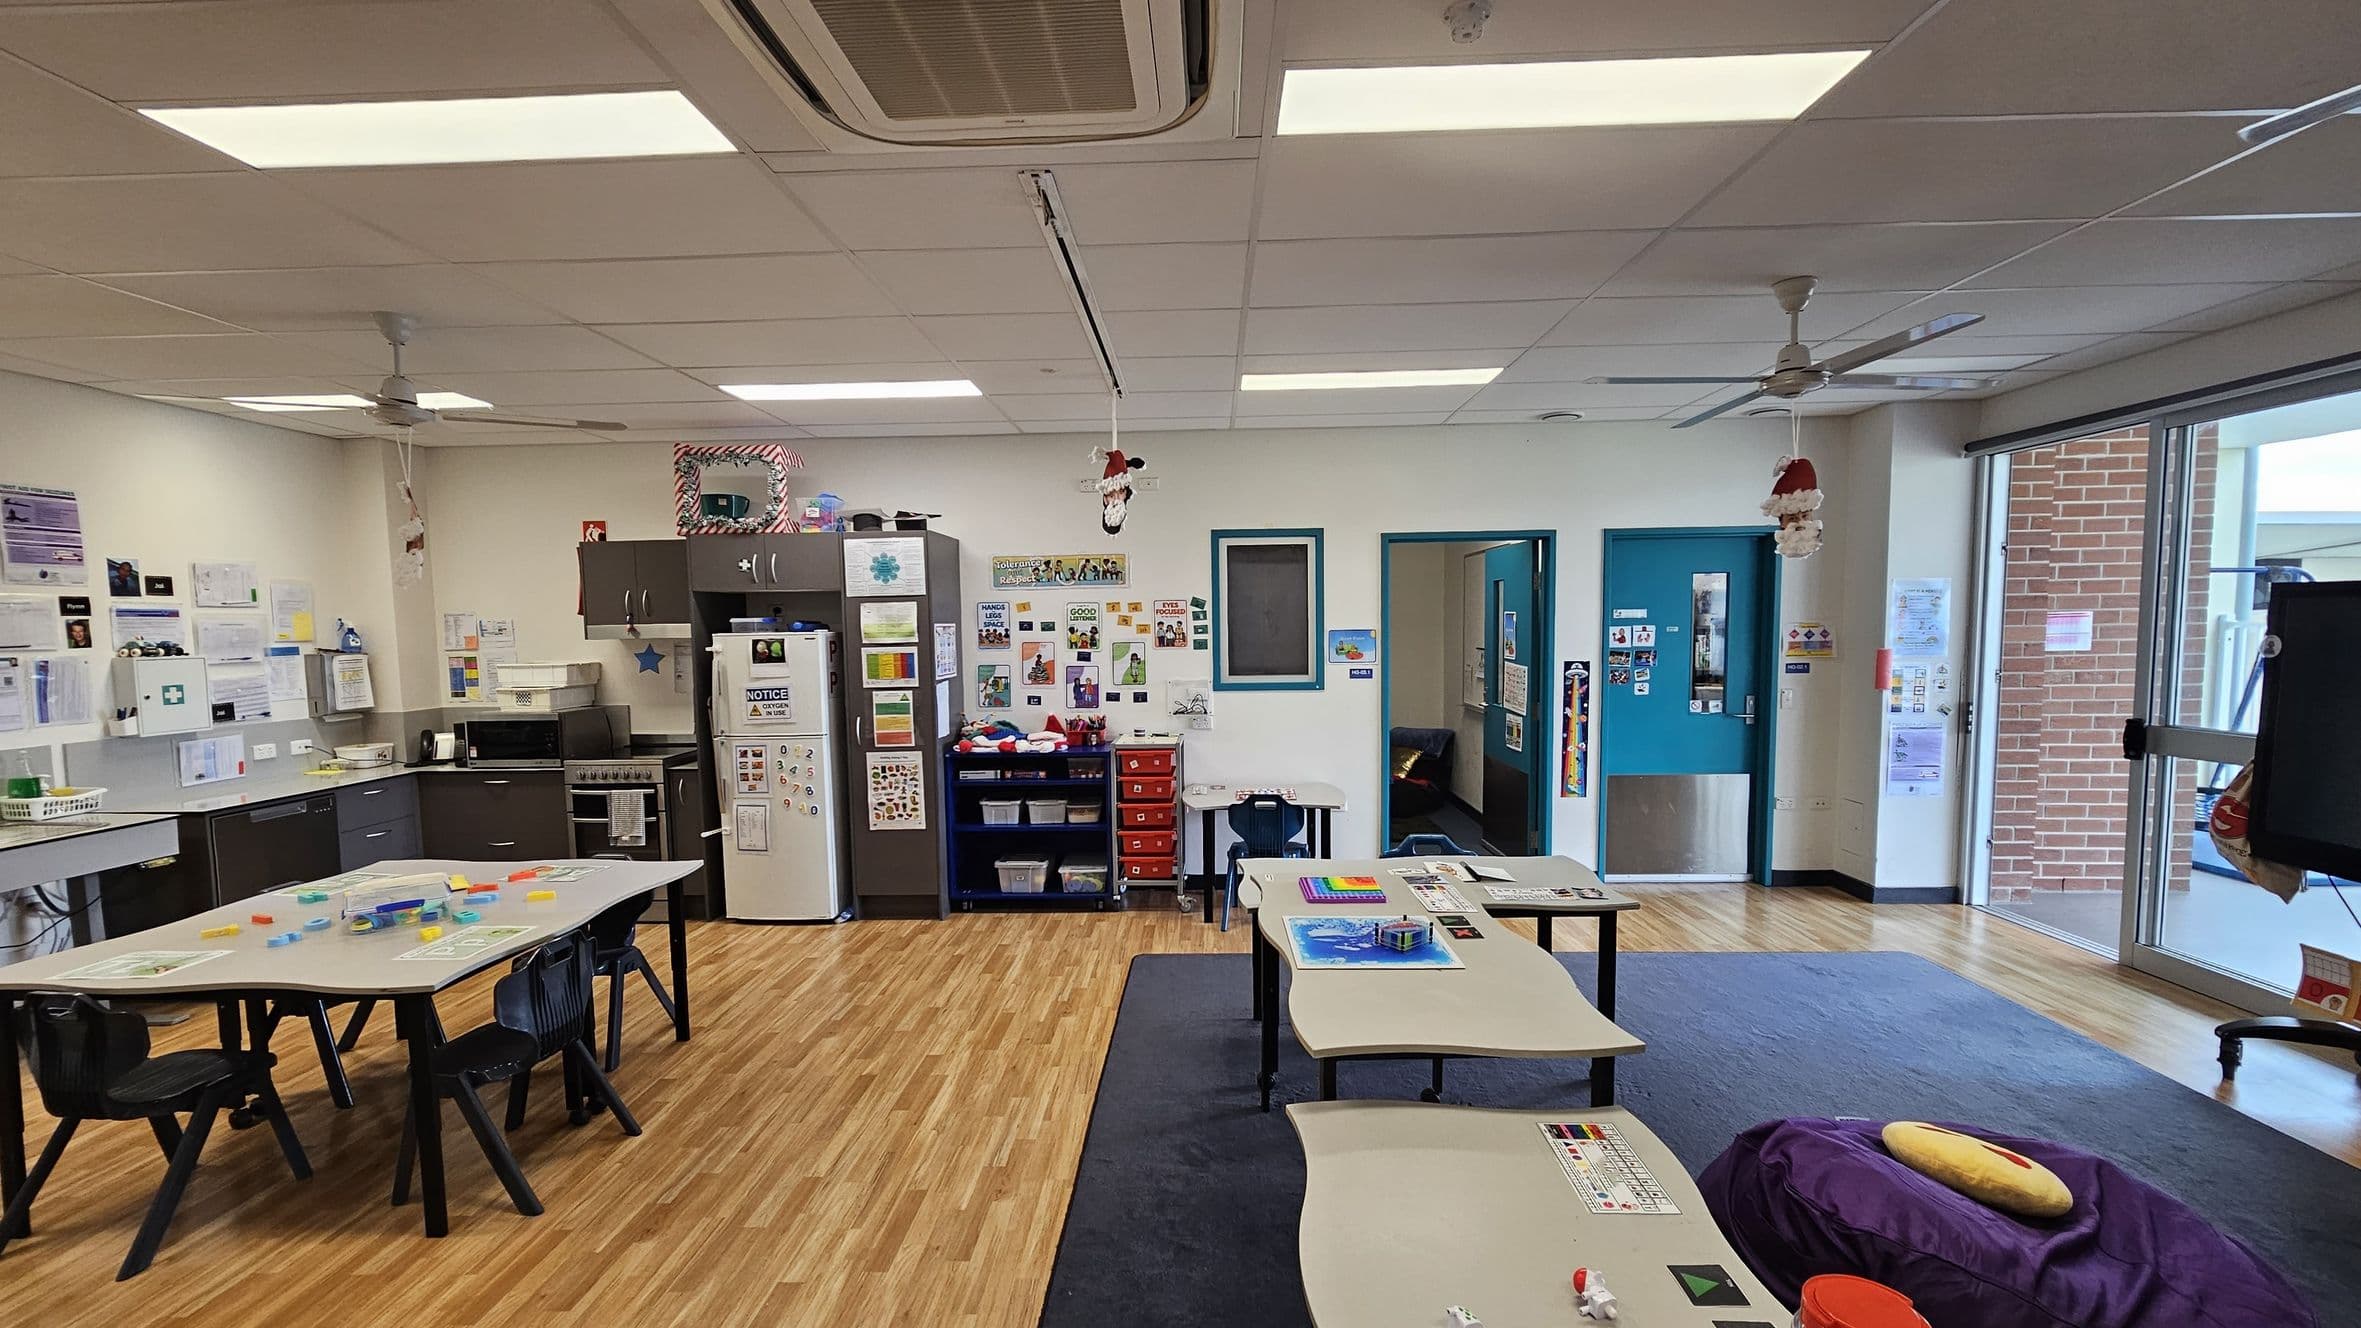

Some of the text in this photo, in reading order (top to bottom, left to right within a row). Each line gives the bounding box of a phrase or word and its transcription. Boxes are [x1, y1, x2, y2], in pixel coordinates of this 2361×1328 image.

[995, 560, 1041, 569] Tolerance
[1000, 576, 1036, 585] Respect
[1070, 607, 1097, 616] GOOD
[746, 689, 788, 701] NOTICE
[762, 702, 789, 710] OXYGEN
